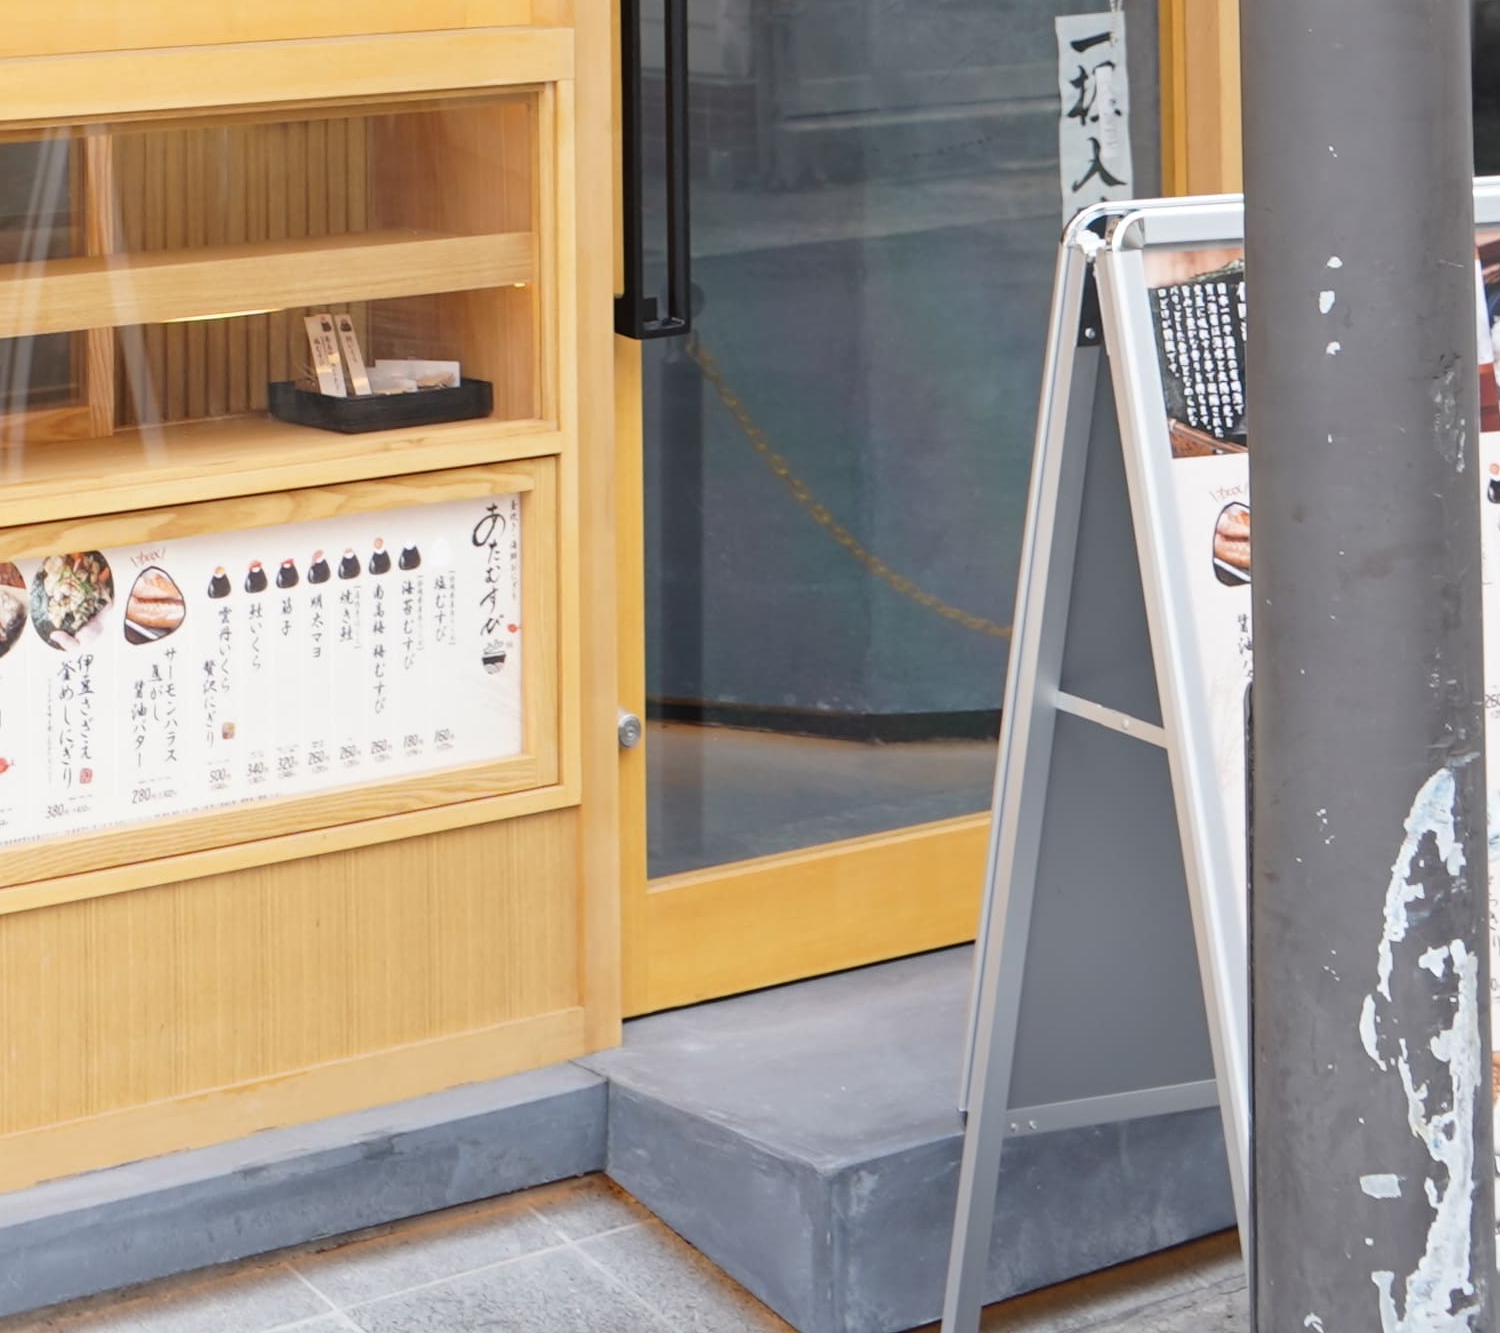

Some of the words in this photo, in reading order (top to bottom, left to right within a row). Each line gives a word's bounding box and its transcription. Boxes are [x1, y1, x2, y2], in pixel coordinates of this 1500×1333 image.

[1067, 31, 1128, 205] 一握入
[471, 502, 507, 636] あたむすび
[57, 659, 77, 790] 釜めしにぎり
